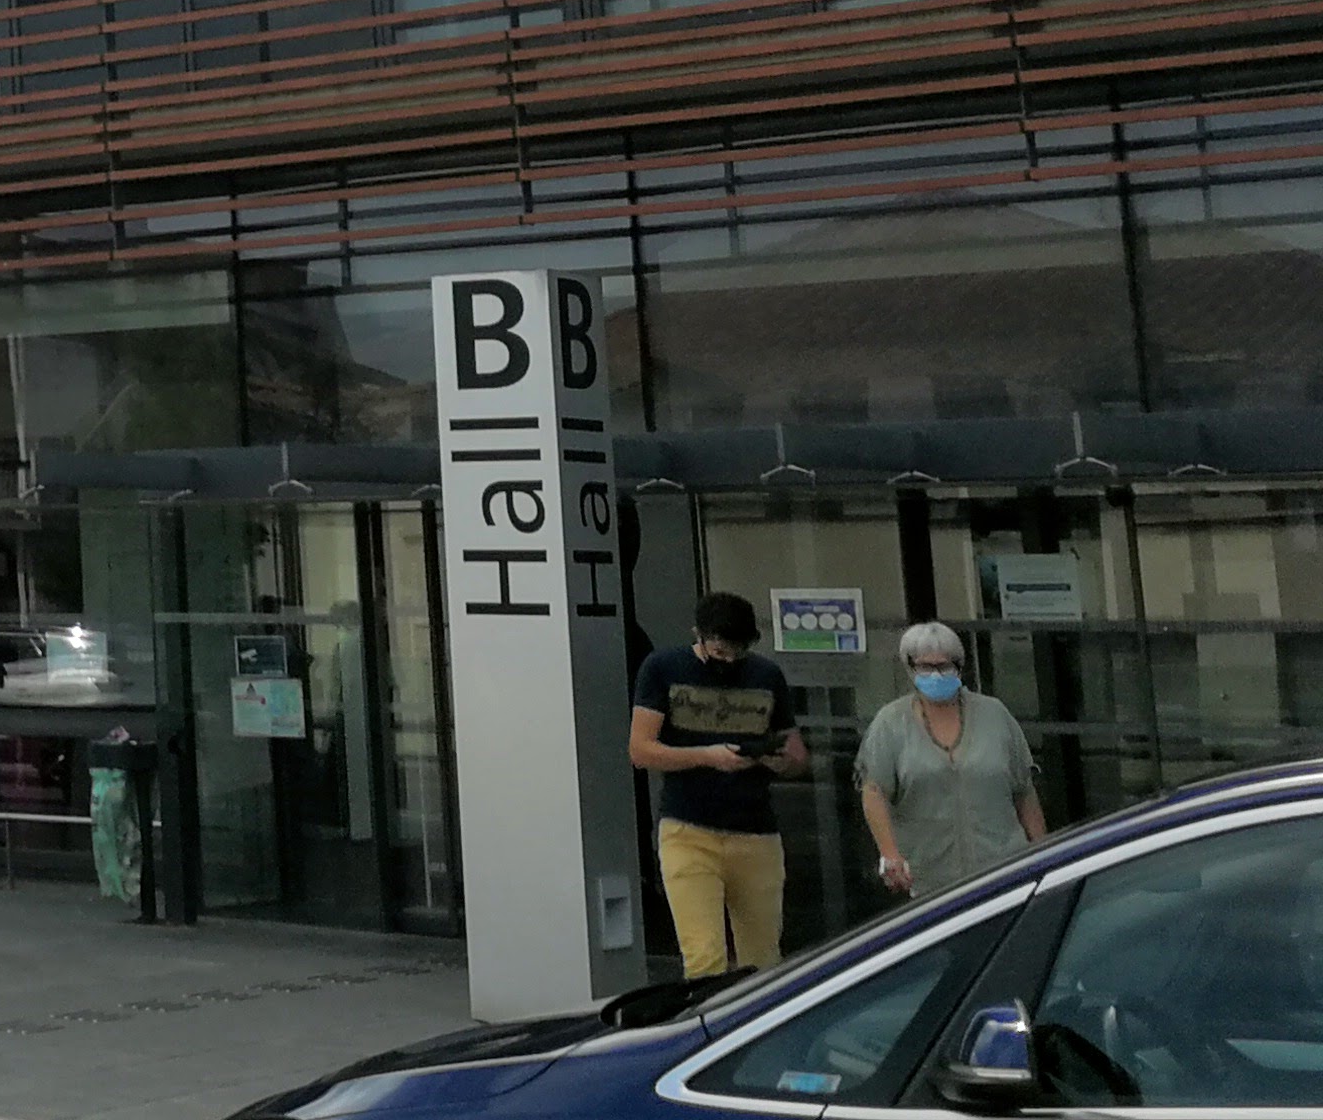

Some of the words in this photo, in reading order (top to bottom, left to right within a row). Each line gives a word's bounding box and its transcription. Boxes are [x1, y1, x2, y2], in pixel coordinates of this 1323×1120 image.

[452, 279, 530, 391] B
[557, 277, 597, 389] B
[450, 417, 551, 616] Hall
[561, 417, 617, 618] Hall
